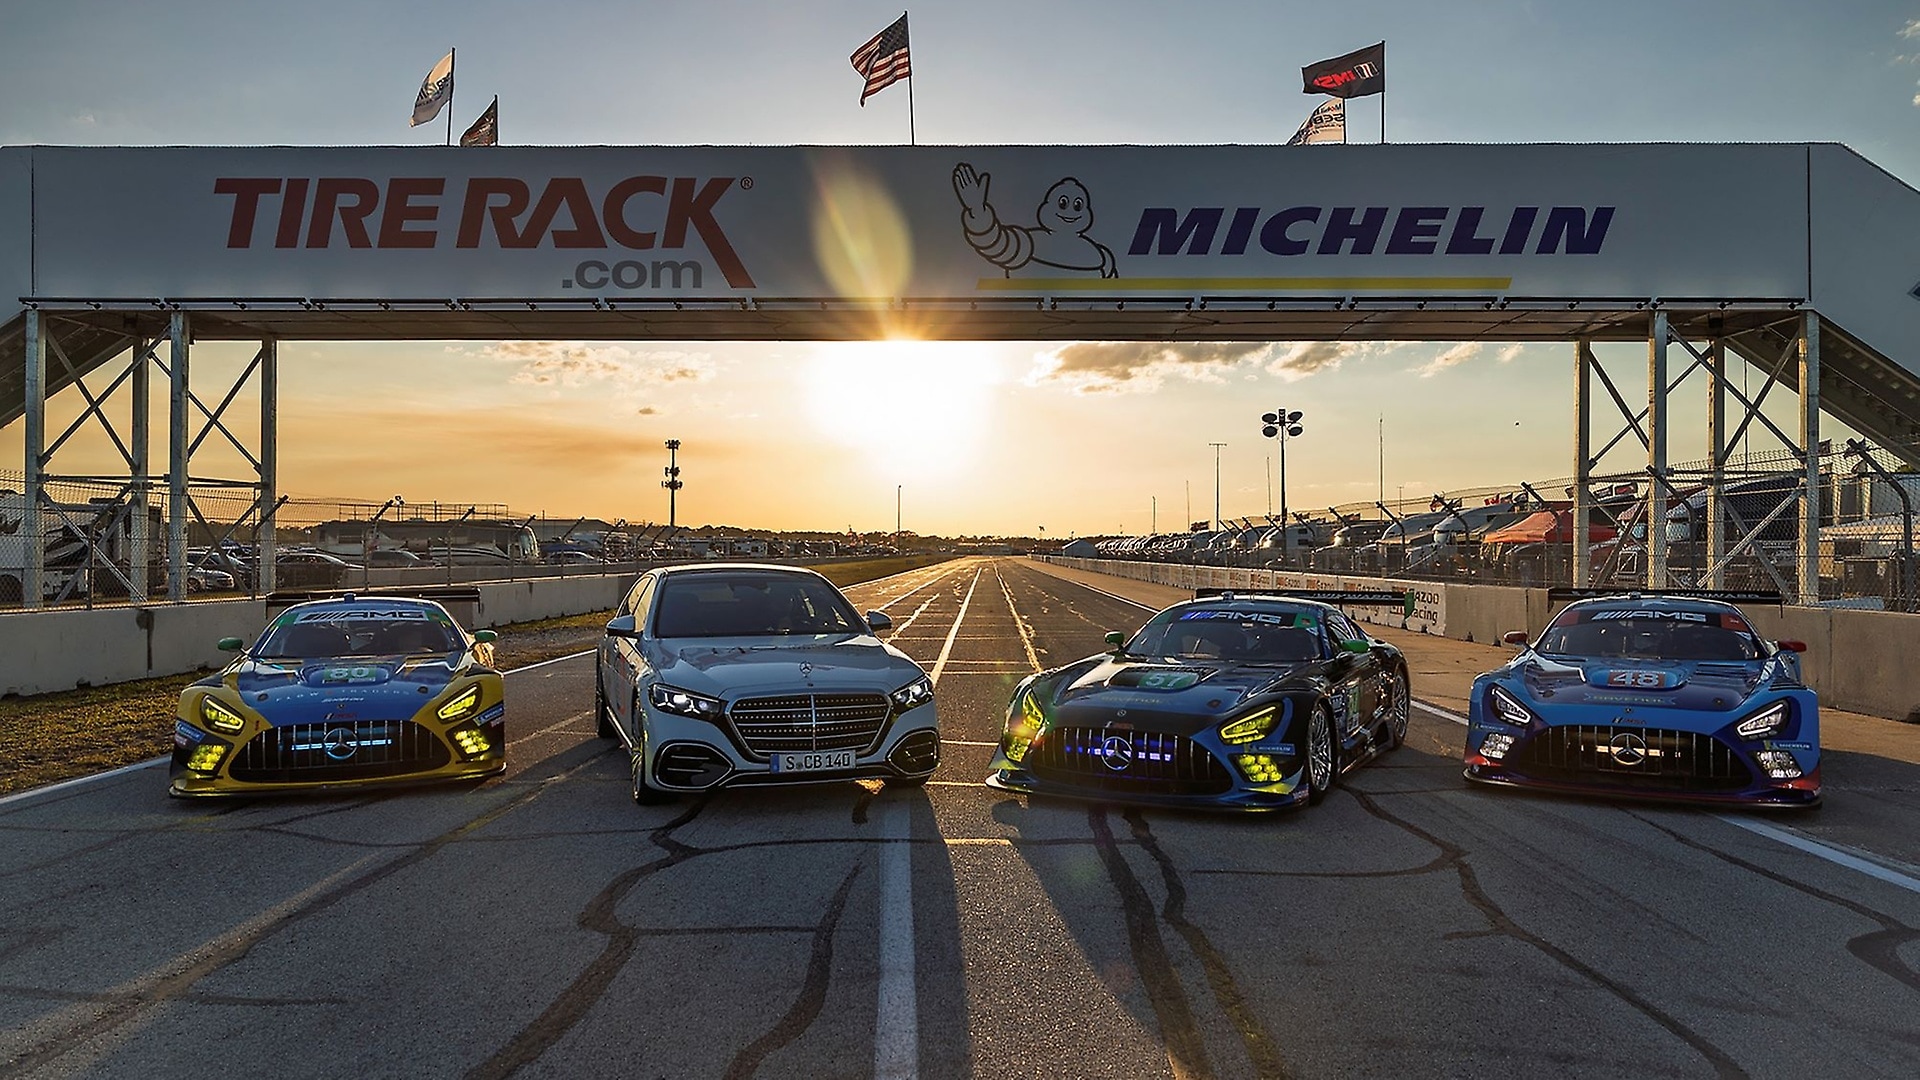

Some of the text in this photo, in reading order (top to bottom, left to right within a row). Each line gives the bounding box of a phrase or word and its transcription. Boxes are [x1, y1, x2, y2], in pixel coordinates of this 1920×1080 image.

[214, 176, 757, 289] TIRE RACK
[1127, 206, 1615, 255] MICHELIN
[562, 259, 702, 289] .com
[1409, 588, 1440, 605] AZOO
[337, 611, 424, 620] AMG
[1211, 611, 1281, 624] AMG
[1411, 605, 1438, 626] acing
[1630, 610, 1706, 622] AMG
[330, 667, 369, 679] 80
[1146, 673, 1188, 687] 57
[1613, 672, 1659, 687] 48
[786, 752, 850, 770] S CB 140
